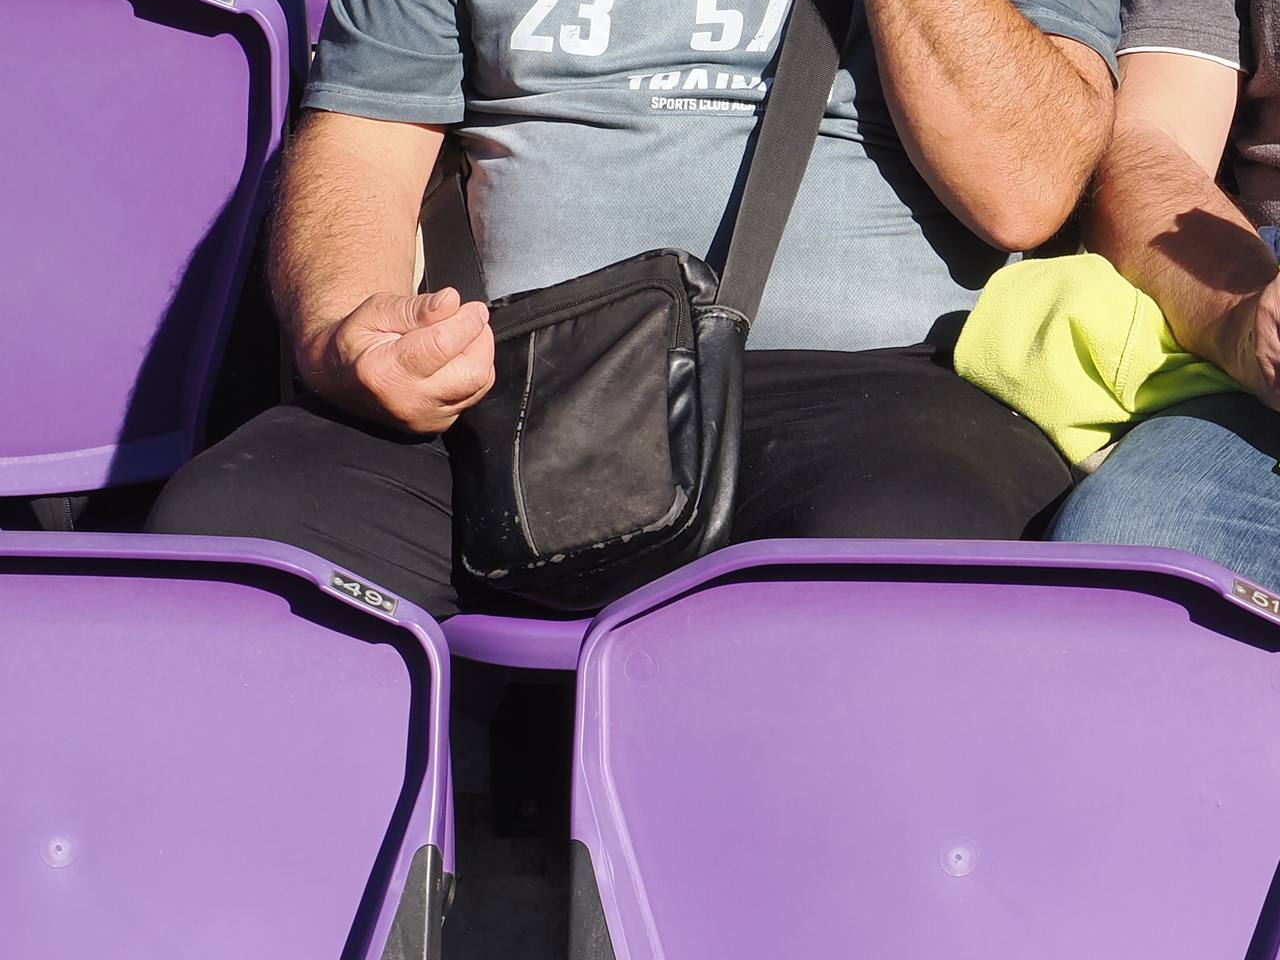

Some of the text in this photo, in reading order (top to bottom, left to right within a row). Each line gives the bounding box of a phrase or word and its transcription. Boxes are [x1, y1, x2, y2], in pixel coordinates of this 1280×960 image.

[650, 96, 697, 111] SPORTS
[699, 98, 729, 112] CLUB
[343, 582, 383, 607] 49
[1251, 590, 1280, 614] 51
